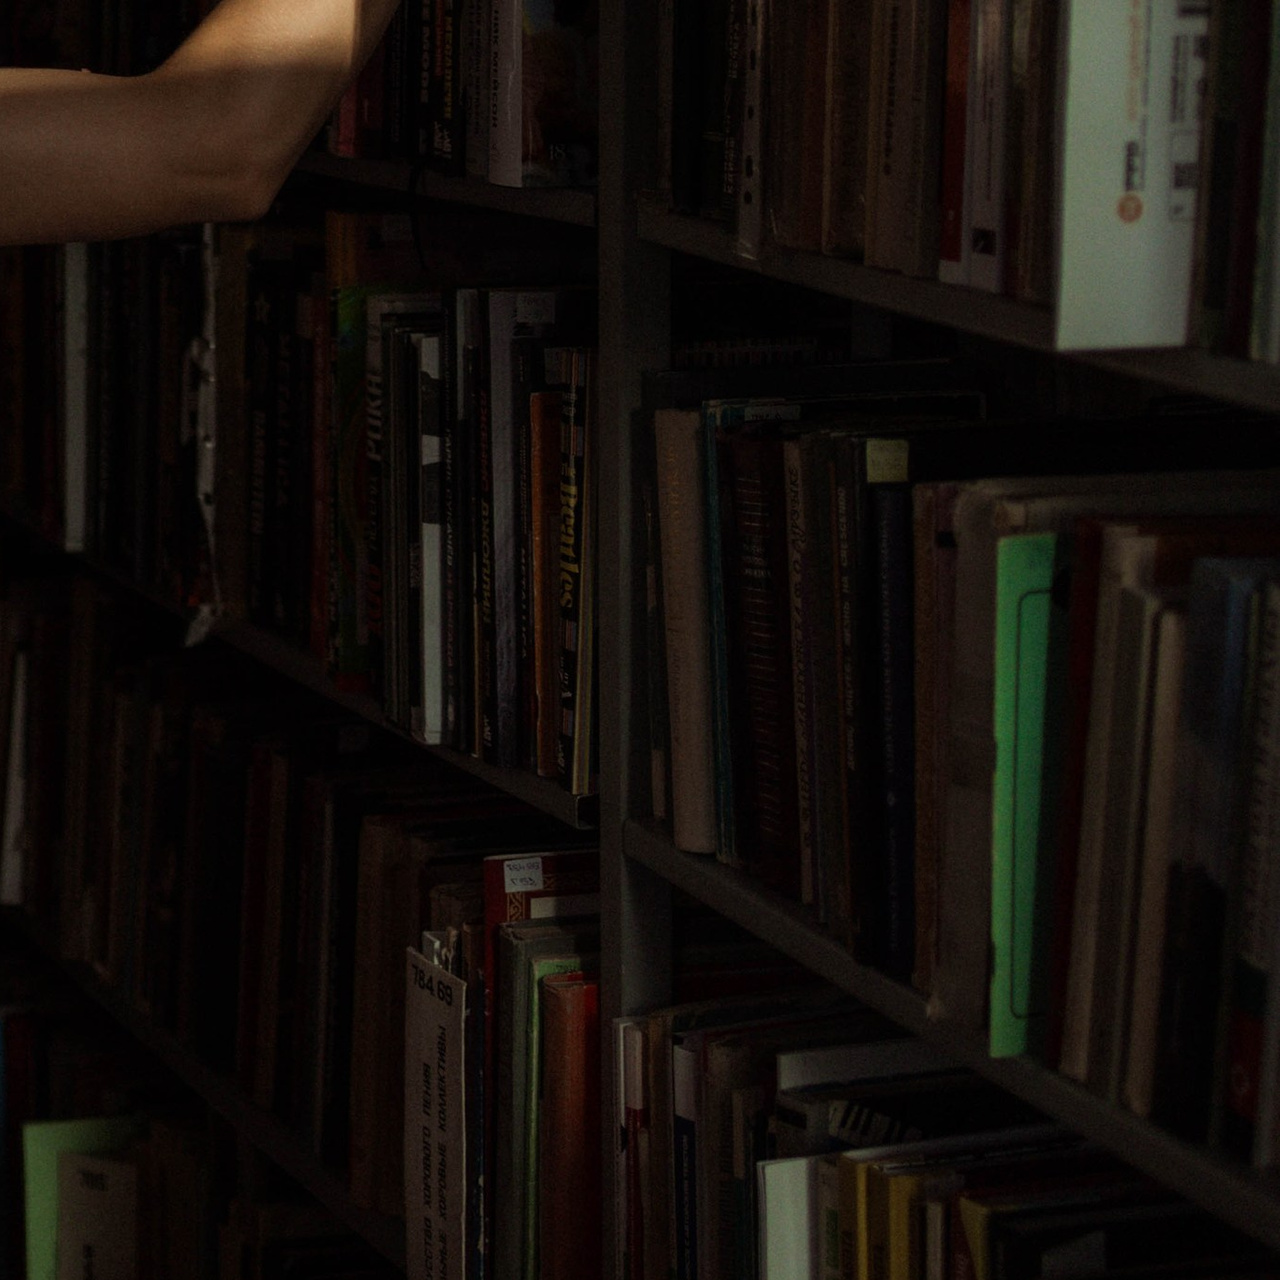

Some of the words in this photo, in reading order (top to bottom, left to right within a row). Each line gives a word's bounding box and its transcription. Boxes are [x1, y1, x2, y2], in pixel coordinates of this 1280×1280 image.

[556, 481, 580, 610] Beatles
[422, 1062, 432, 1117] ПЕНИЯ
[437, 1025, 447, 1132] КОЛЛЕКТИВЫ
[422, 1125, 433, 1206] ХОРОВОГО
[437, 1143, 448, 1221] ХОРОВЫЕ
